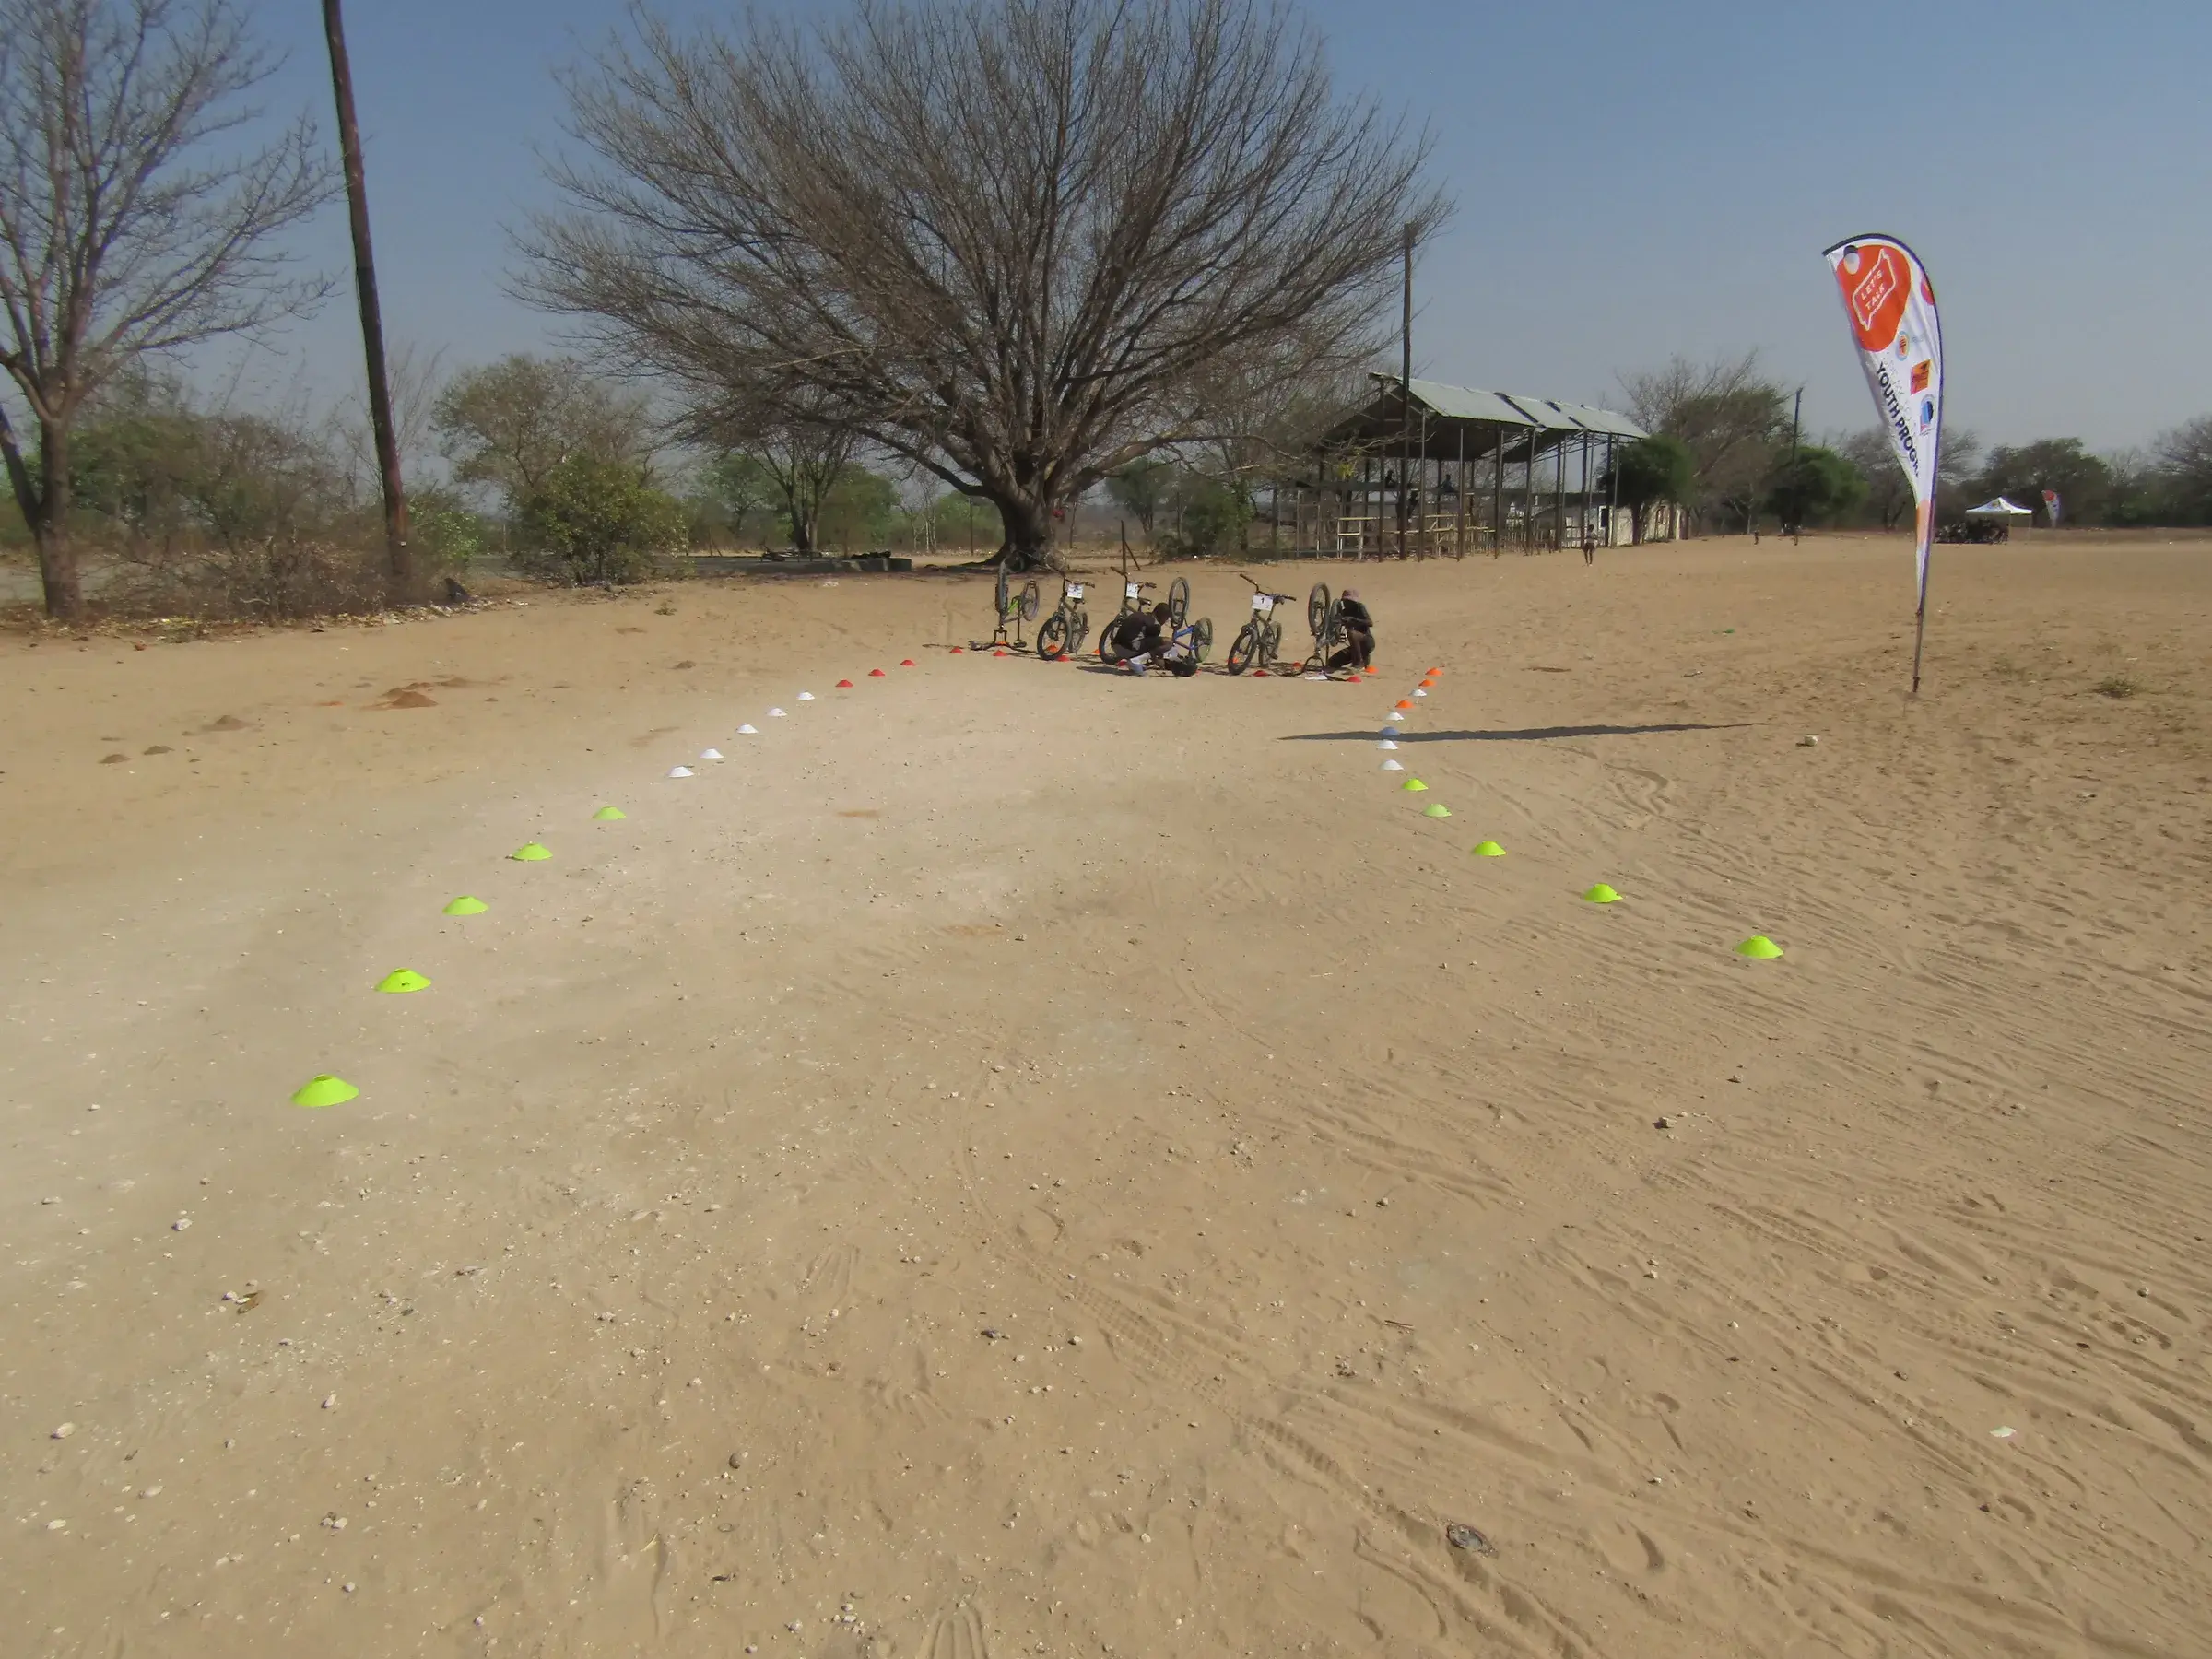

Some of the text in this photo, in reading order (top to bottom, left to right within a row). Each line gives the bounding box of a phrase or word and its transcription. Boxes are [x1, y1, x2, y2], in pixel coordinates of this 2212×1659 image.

[1861, 269, 1883, 300] LET'S
[1865, 283, 1885, 311] TALK
[1876, 361, 1900, 418] YOUTH
